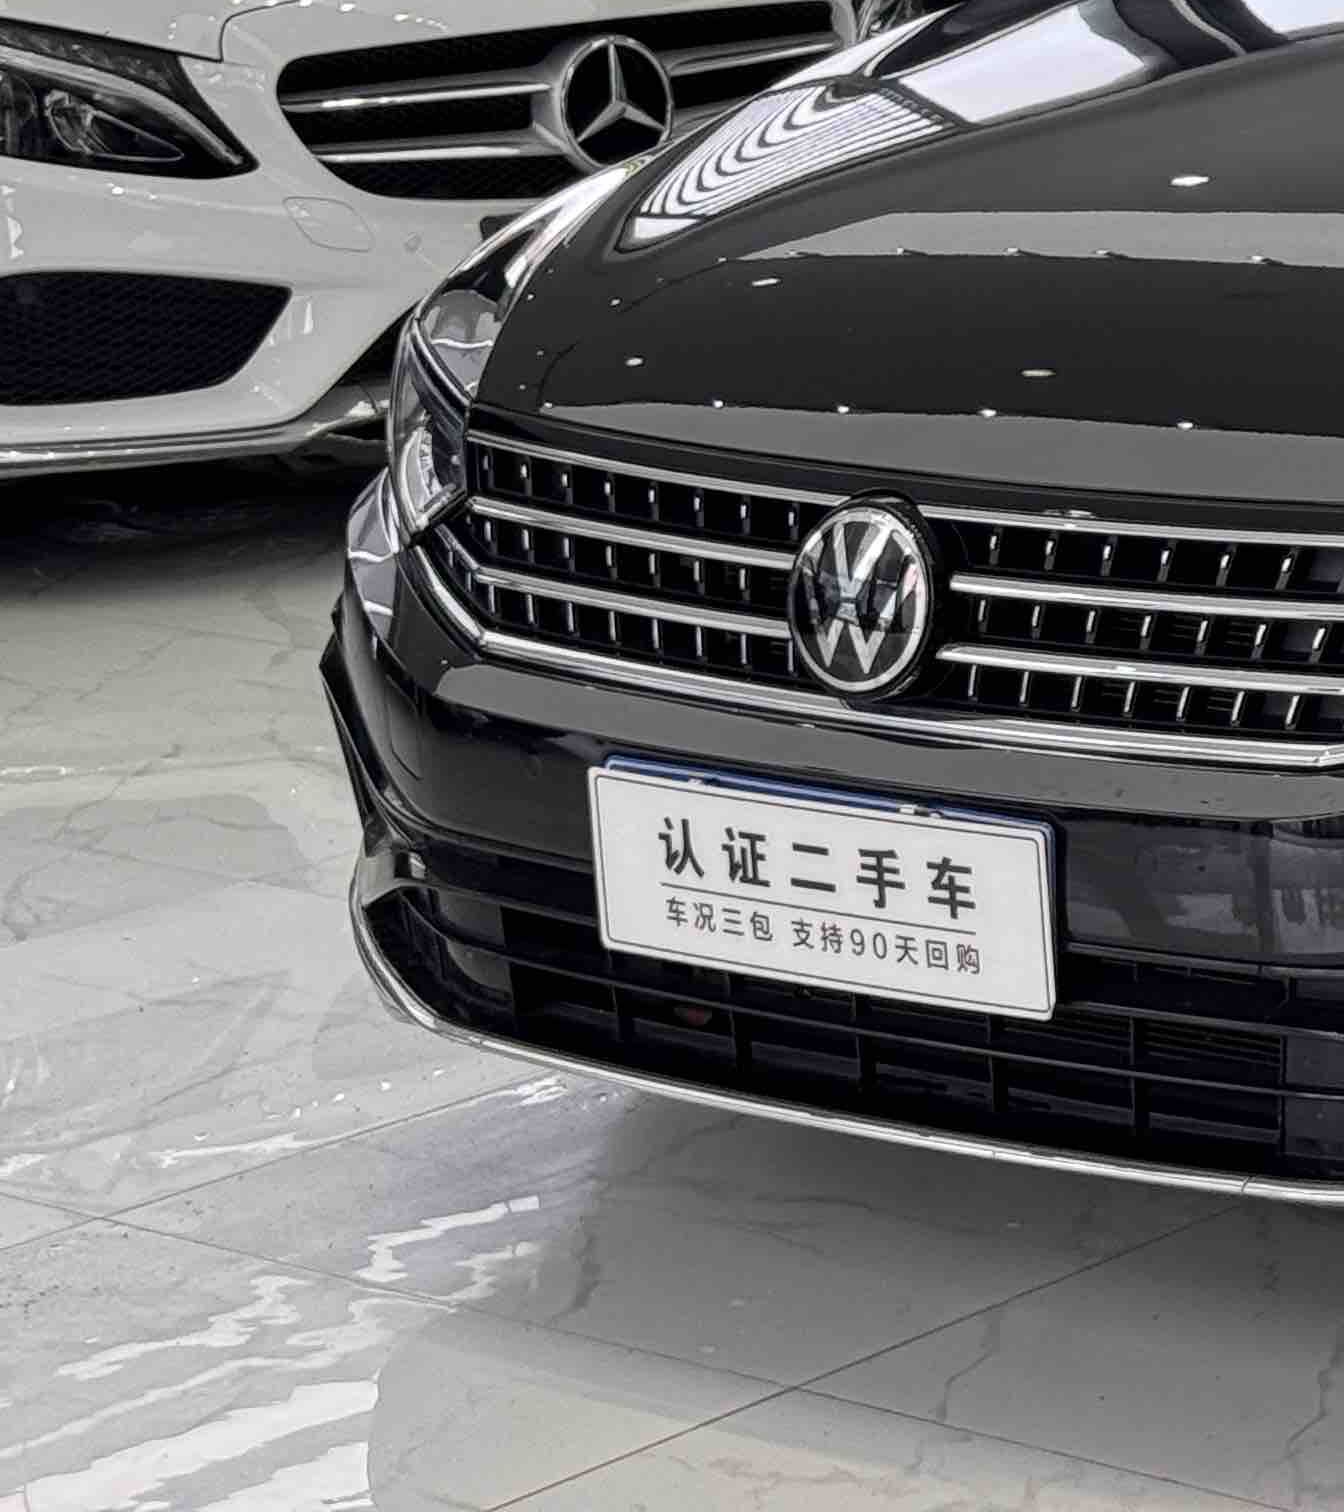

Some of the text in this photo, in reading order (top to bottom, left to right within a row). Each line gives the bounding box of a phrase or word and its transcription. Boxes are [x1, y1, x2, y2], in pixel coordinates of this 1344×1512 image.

[658, 816, 977, 919] 认证二手车
[665, 895, 981, 975] 车况三包 支持90天回购
